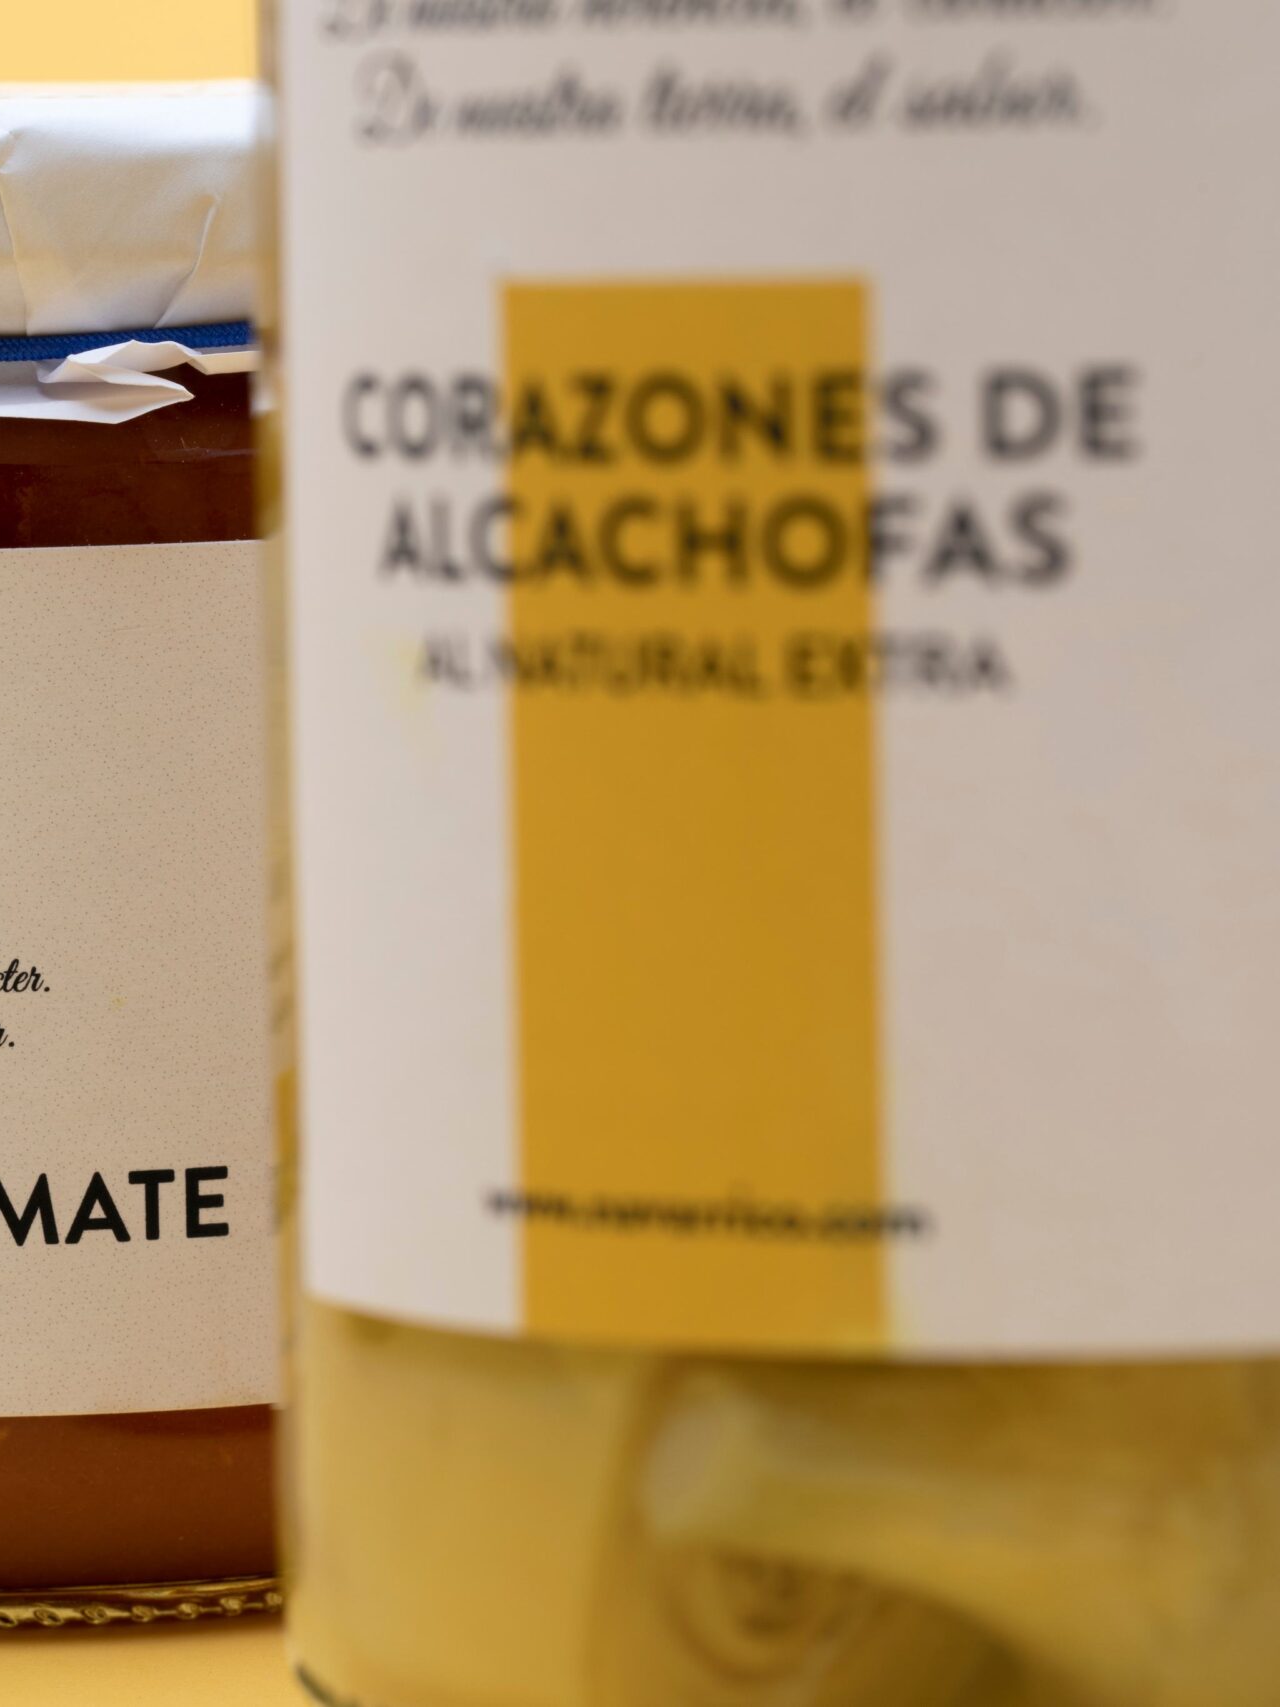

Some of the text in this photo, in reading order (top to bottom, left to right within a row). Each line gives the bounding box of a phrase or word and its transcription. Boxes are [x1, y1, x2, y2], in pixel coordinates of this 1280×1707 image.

[342, 365, 1142, 465] CORAZONES DE
[380, 491, 1076, 588] ALCACHOFAS
[484, 630, 762, 699] NATURAL
[779, 628, 1015, 696] EXTRA
